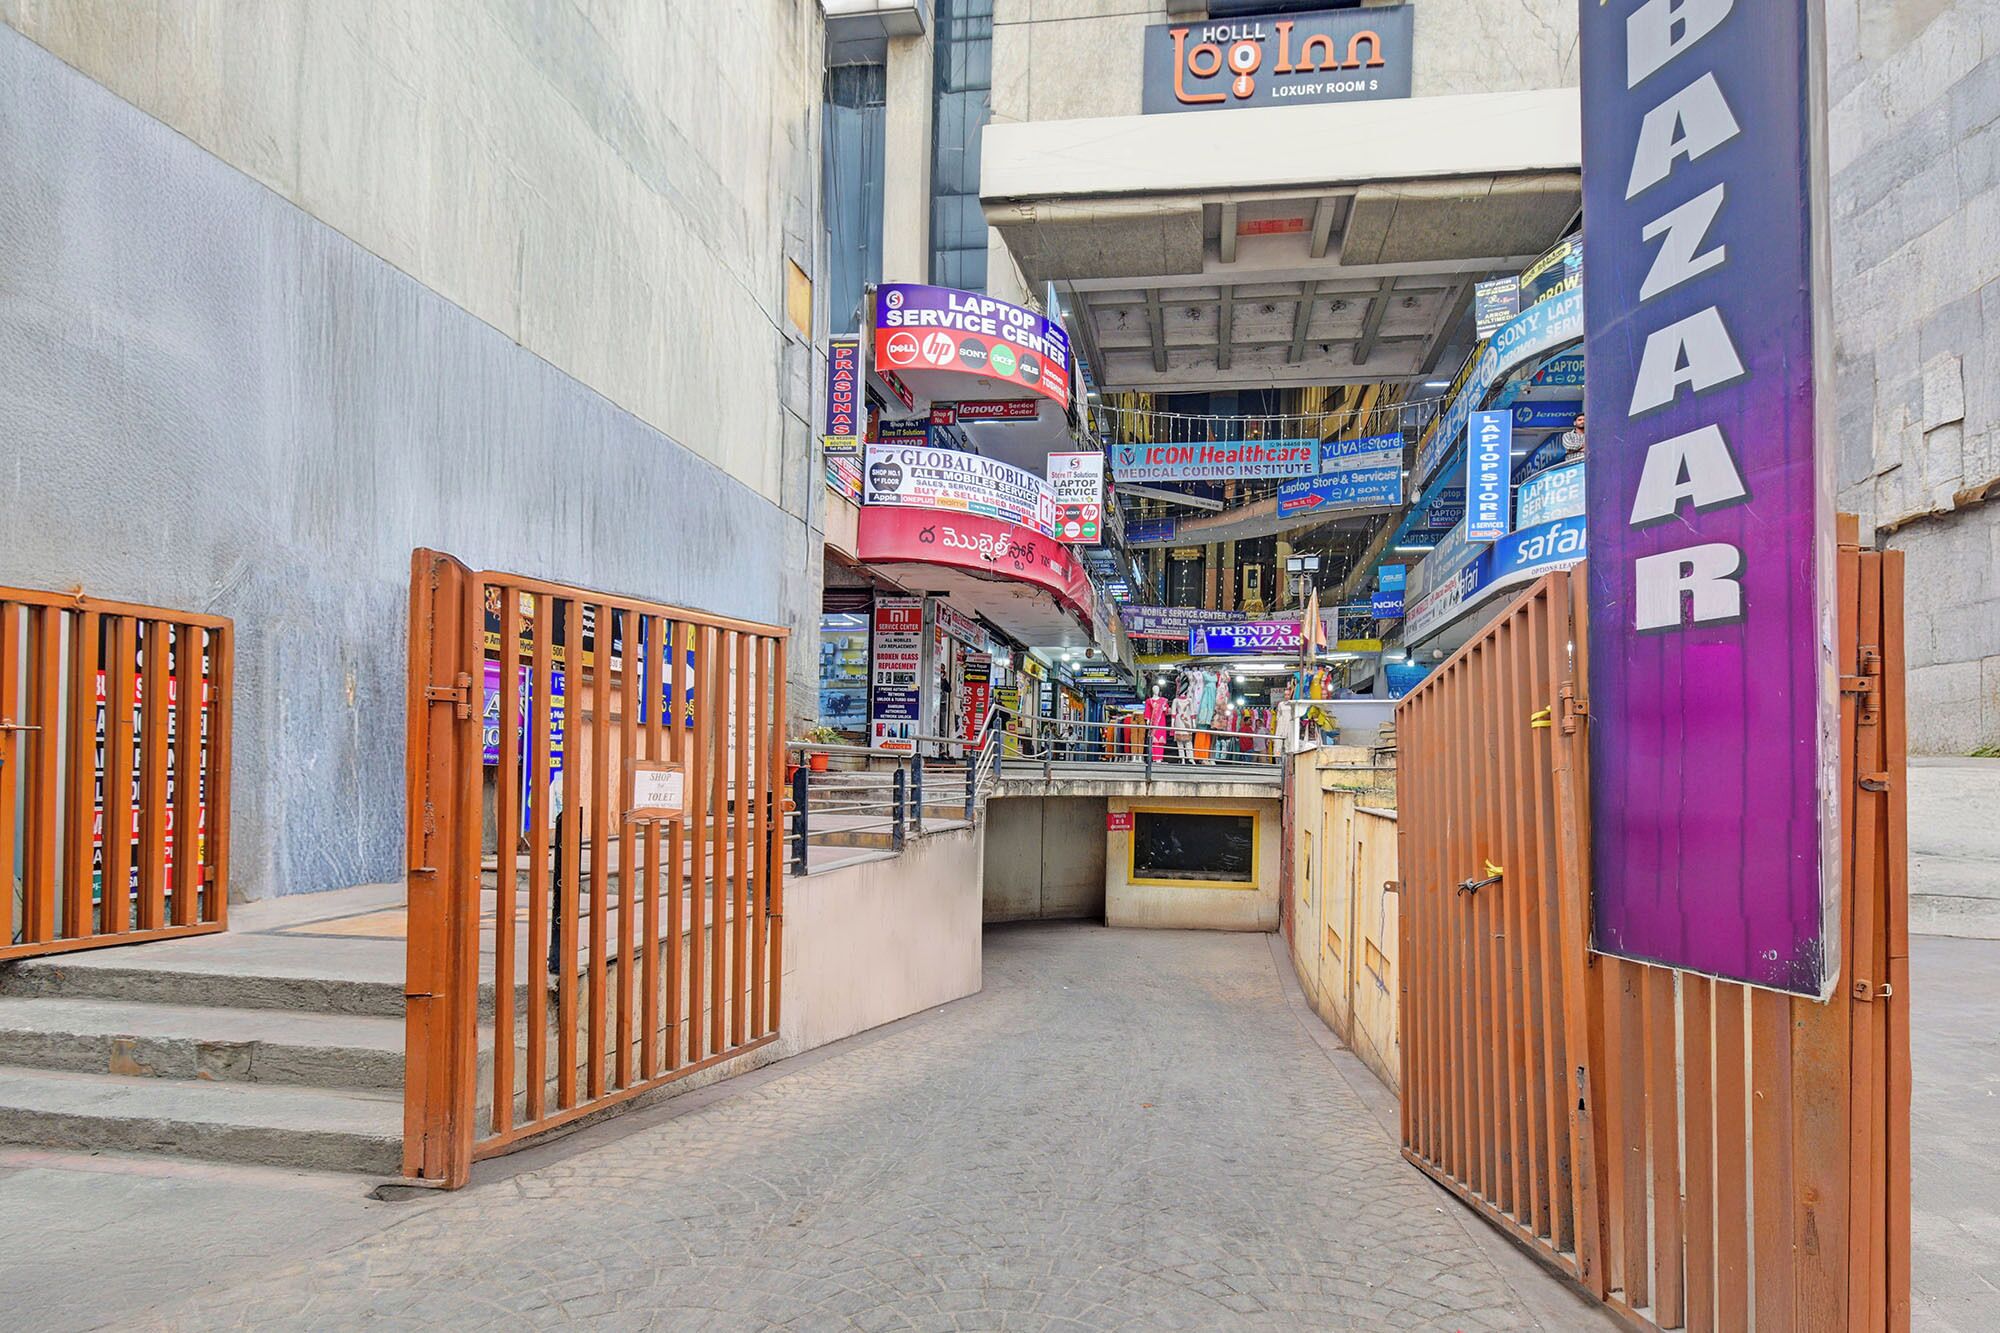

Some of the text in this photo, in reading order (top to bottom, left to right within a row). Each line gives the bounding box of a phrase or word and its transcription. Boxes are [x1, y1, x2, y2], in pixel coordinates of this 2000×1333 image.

[1203, 25, 1266, 42] HOLLL
[1169, 21, 1386, 103] Log Inn
[948, 293, 1035, 330] LAPTOP
[1625, 0, 1747, 631] BAZAAR
[886, 309, 997, 336] SERVICE
[1002, 324, 1066, 369] CENTER
[1497, 312, 1541, 352] SONY
[959, 348, 987, 360] SONY
[832, 348, 854, 435] PRASUNAS
[960, 403, 1005, 415] lenovo
[900, 449, 977, 474] GLOBAL
[1145, 444, 1312, 465] ICON Healthcare
[980, 460, 1041, 495] MOBILES
[1118, 463, 1313, 479] MEDICAL CODING INSTITUTE
[914, 468, 1037, 505] ALL MOBILES SERVICE
[1053, 480, 1096, 488] LAPTOP
[1058, 488, 1098, 496] ERVICE
[1280, 479, 1311, 495] Laptop
[1523, 468, 1578, 502] LAPTOP
[873, 493, 897, 502] Apple
[913, 487, 937, 496] BUY
[953, 491, 980, 502] SELL
[982, 495, 1007, 508] USED
[1522, 483, 1580, 519] SERVICE
[1141, 607, 1168, 617] MOBILE
[1207, 625, 1293, 637] TREND'S
[877, 652, 919, 661] BROKEN GLASS
[878, 662, 917, 670] REPLACEMENT
[649, 773, 671, 782] SHOP
